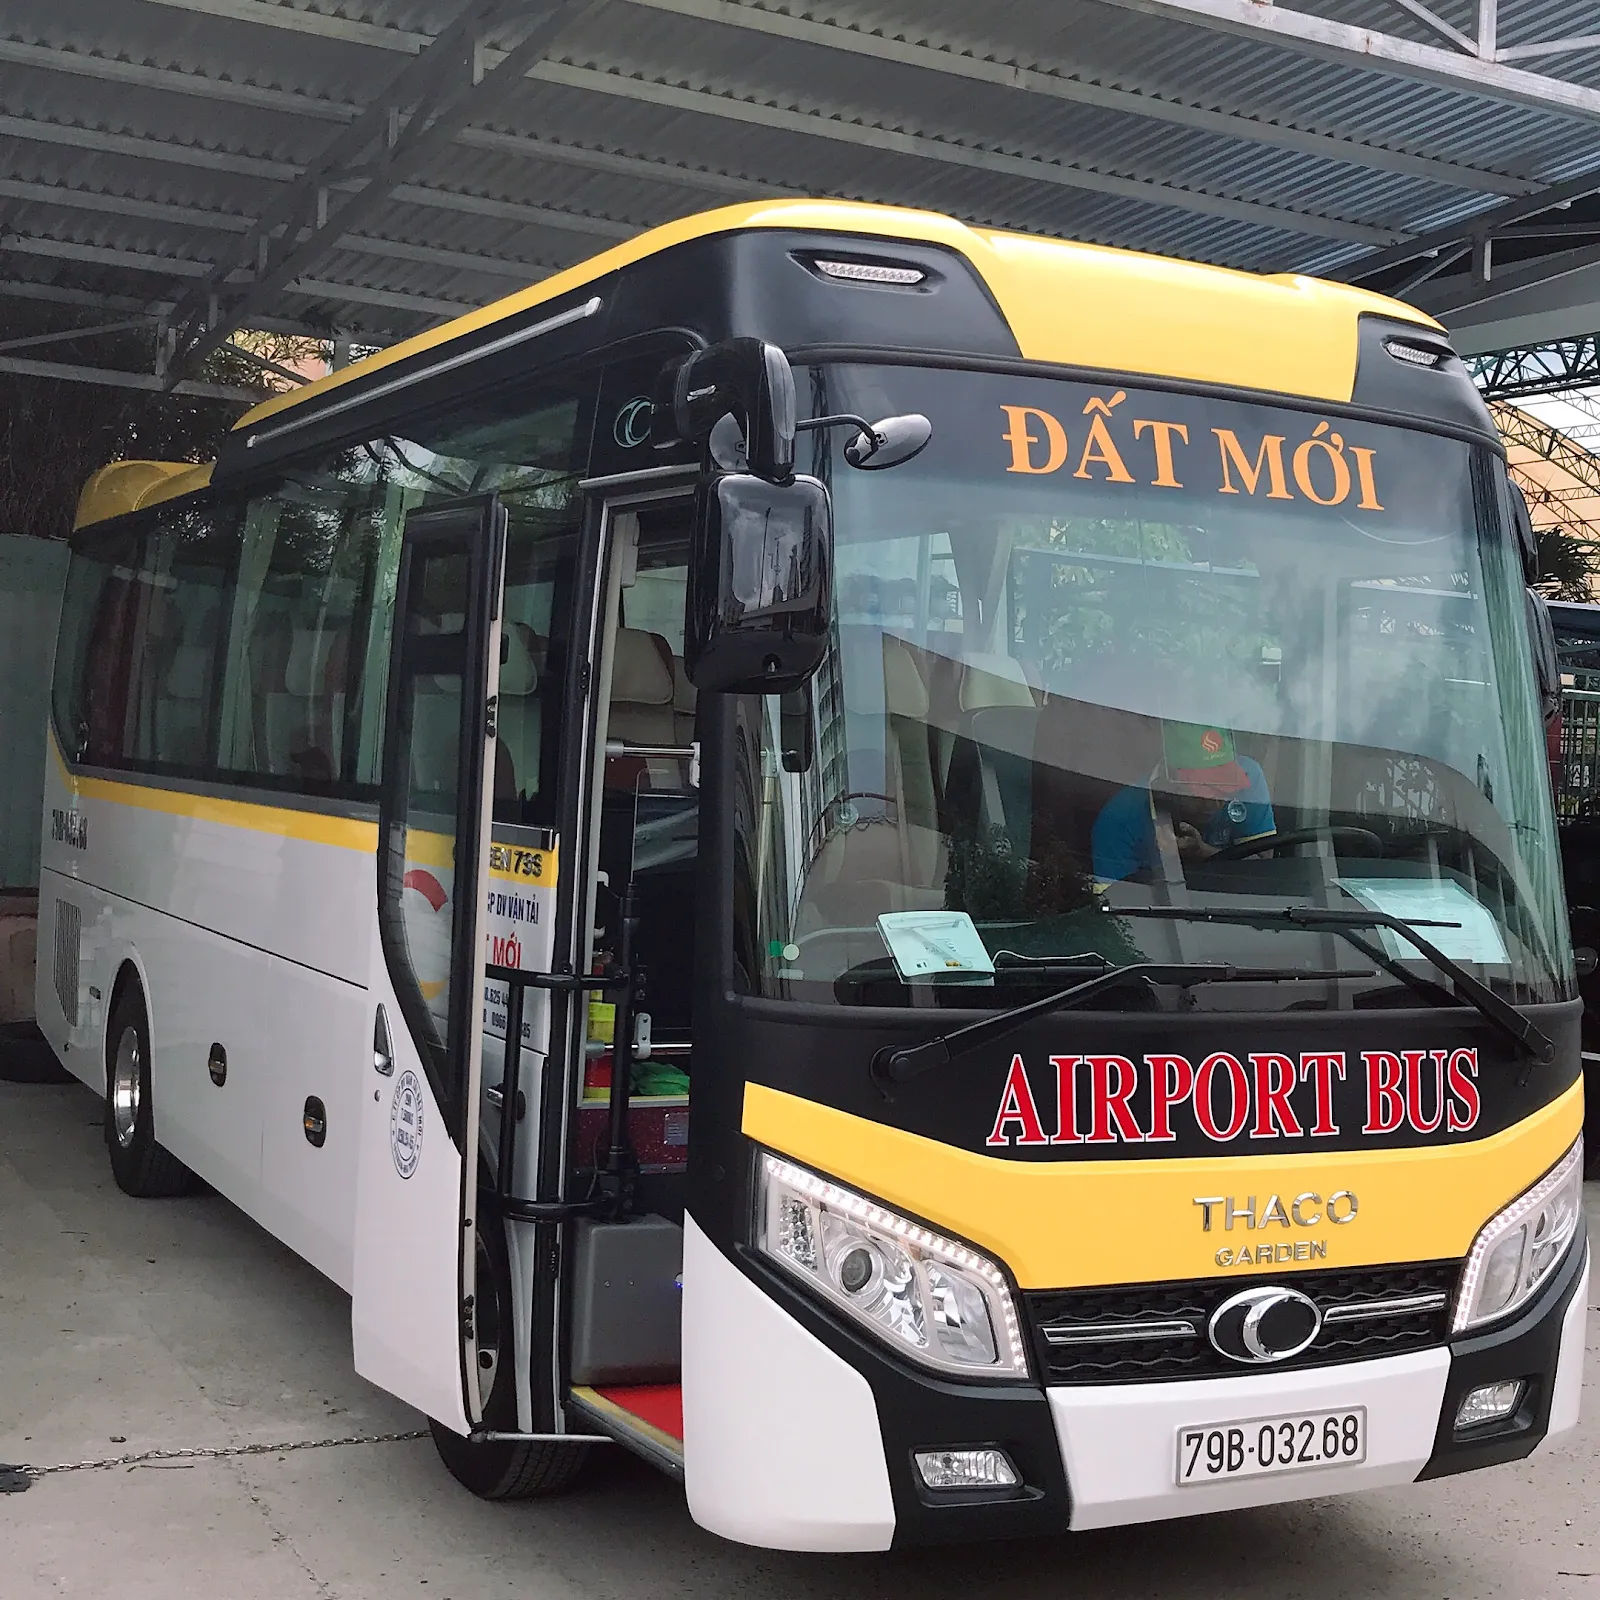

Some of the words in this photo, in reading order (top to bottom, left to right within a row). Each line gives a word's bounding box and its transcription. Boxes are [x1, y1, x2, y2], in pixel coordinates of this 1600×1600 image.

[1000, 390, 1189, 488] ĐẤT
[1211, 421, 1385, 511] MỚI
[497, 893, 508, 917] DV
[508, 892, 525, 924] VẬN
[526, 893, 539, 925] TẢI
[492, 931, 522, 969] MỚI
[986, 1050, 1346, 1146] AIRPORT
[1360, 1048, 1481, 1136] BUS
[1193, 1190, 1359, 1232] THACO
[1214, 1239, 1328, 1267] GARDEN
[1185, 1414, 1359, 1477] 79B-032.68
